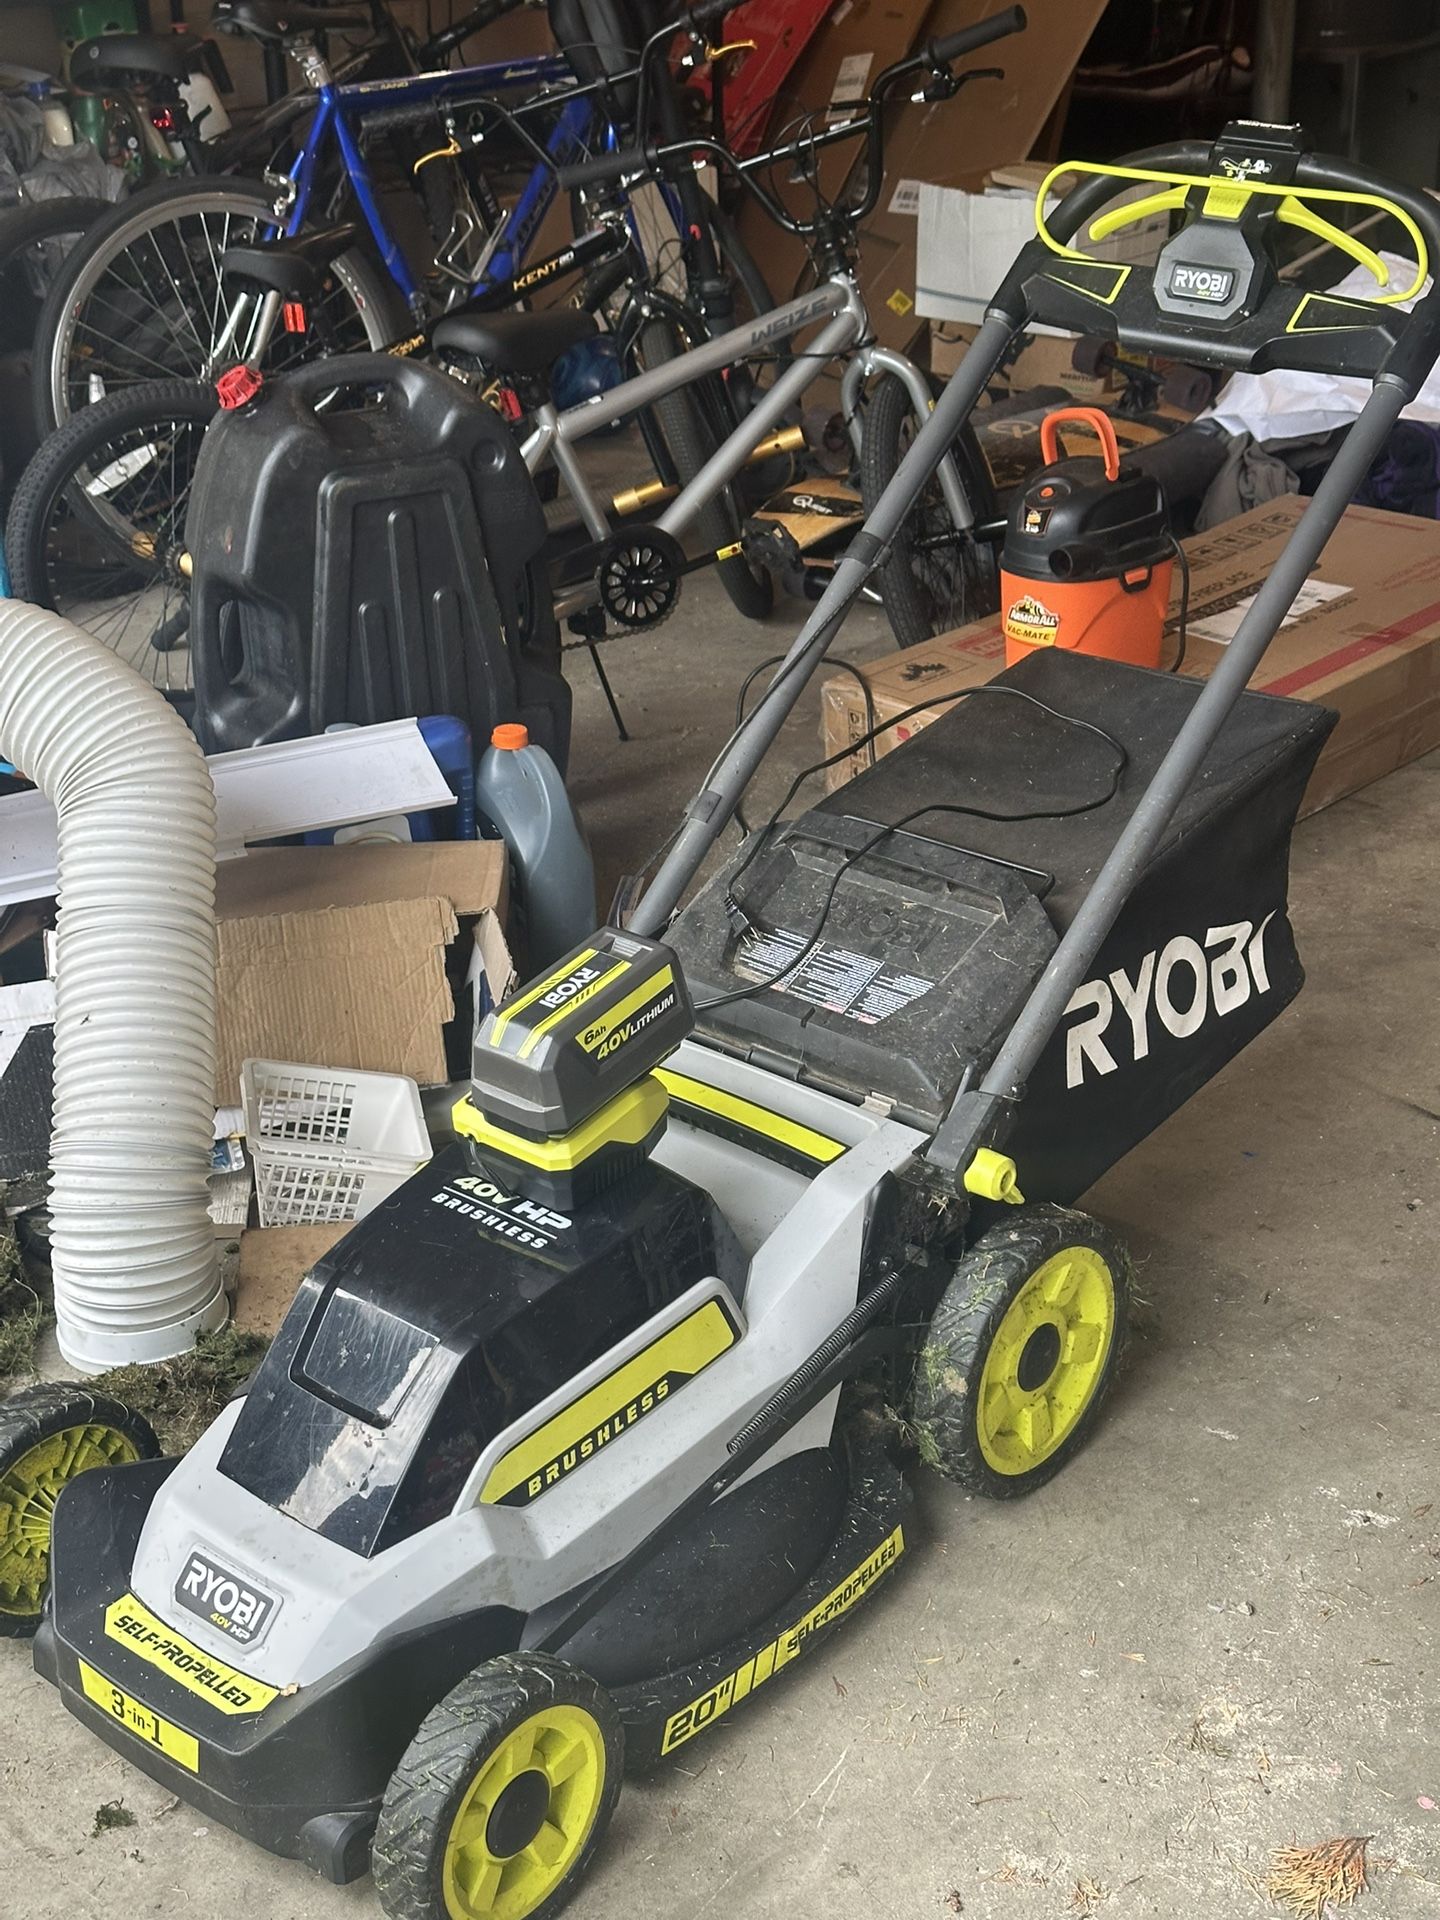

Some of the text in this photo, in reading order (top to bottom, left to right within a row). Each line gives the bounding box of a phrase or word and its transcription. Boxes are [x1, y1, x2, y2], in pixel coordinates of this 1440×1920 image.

[513, 260, 559, 292] KENT
[1175, 269, 1228, 293] RYOBI
[752, 296, 828, 345] WEIZE
[1007, 624, 1052, 641] VAC-MATE
[539, 967, 600, 1009] RYOBI
[1062, 909, 1277, 1089] RYOBI
[584, 1024, 607, 1046] 6Ah
[597, 993, 675, 1060] 40V LITHIUM
[431, 1192, 548, 1249] BRUSHLESS
[453, 1176, 573, 1229] 40V HP
[528, 1379, 669, 1497] BRUSHLESS
[182, 1558, 266, 1631] RYOBI
[210, 1612, 251, 1641] 40V HP
[667, 1540, 896, 1748] 20" SELF-PROPELLED
[113, 1614, 252, 1707] SELF-PROPELLED
[111, 1688, 163, 1747] 3-in-1
